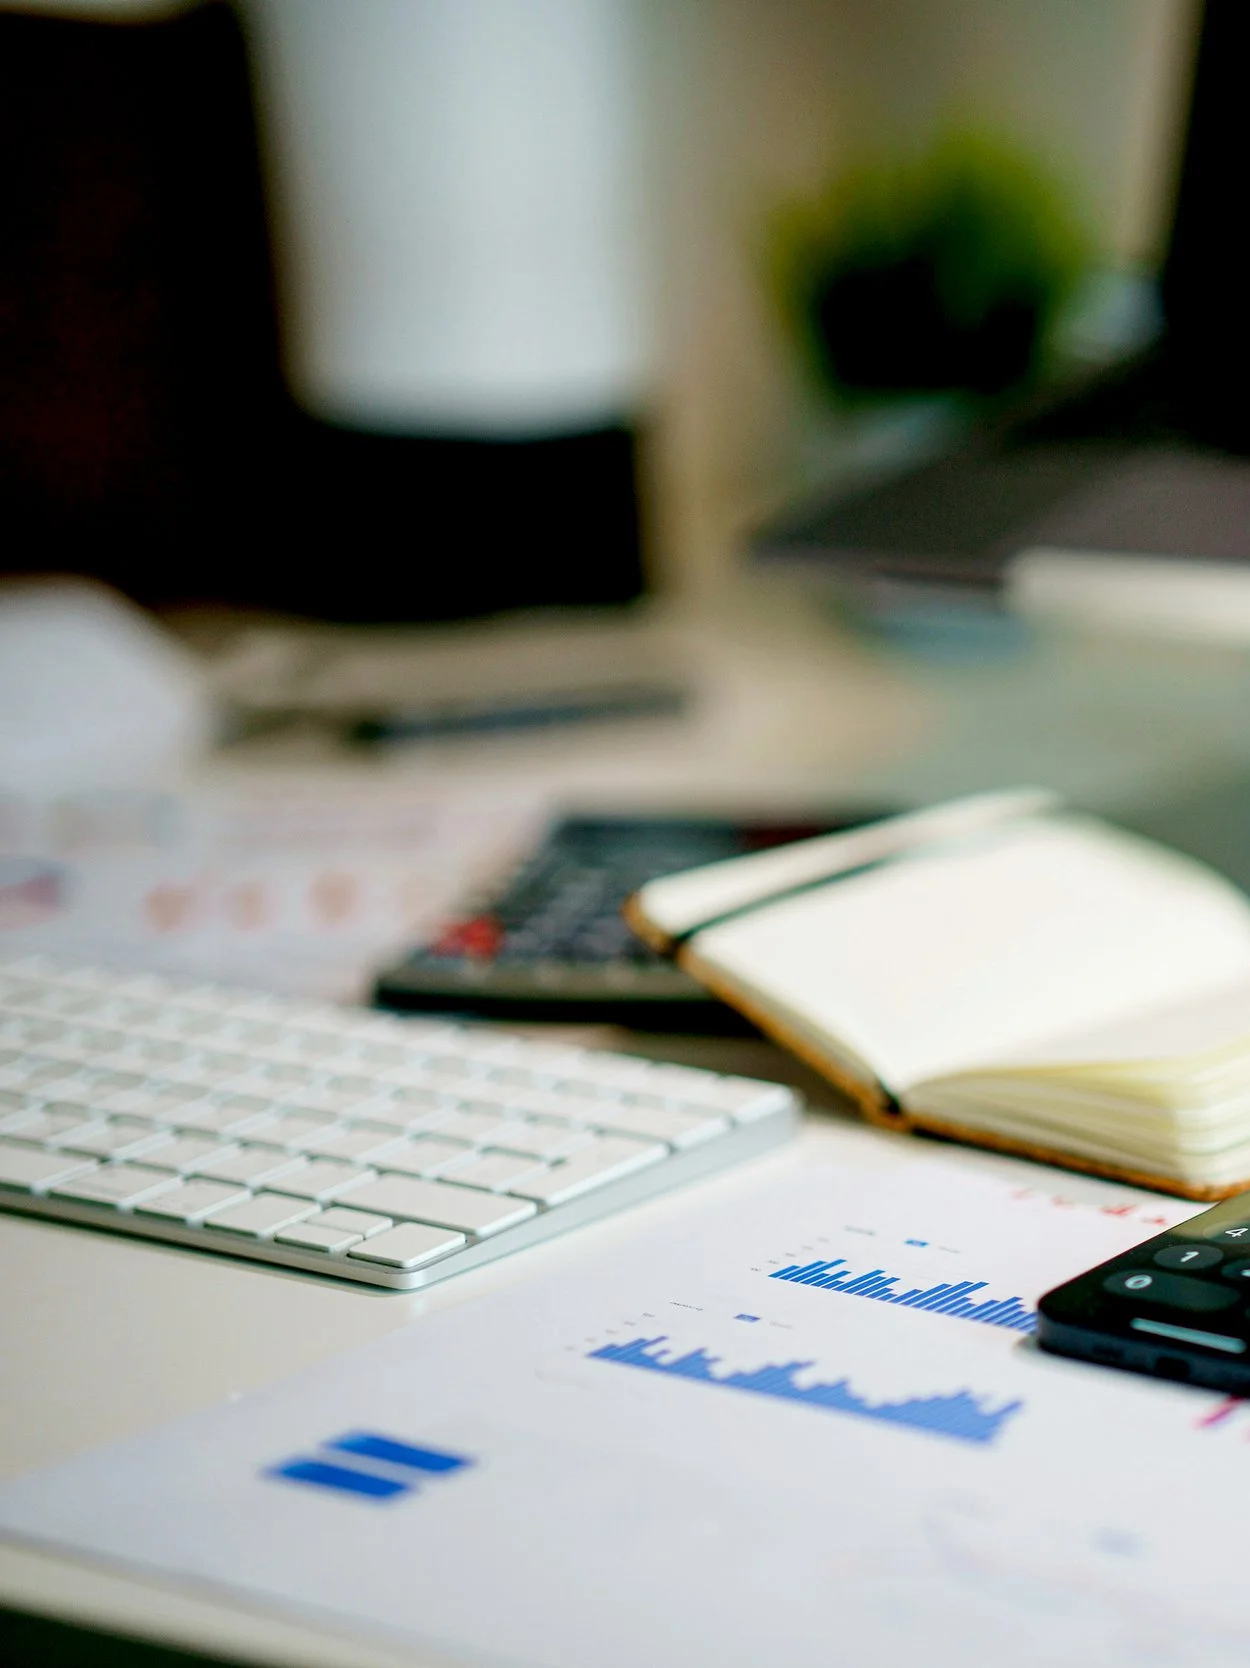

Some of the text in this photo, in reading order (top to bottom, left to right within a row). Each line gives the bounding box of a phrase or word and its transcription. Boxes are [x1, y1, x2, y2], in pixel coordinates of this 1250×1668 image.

[1225, 1227, 1249, 1238] 4
[1179, 1250, 1199, 1263] 1
[1124, 1274, 1153, 1290] 0
